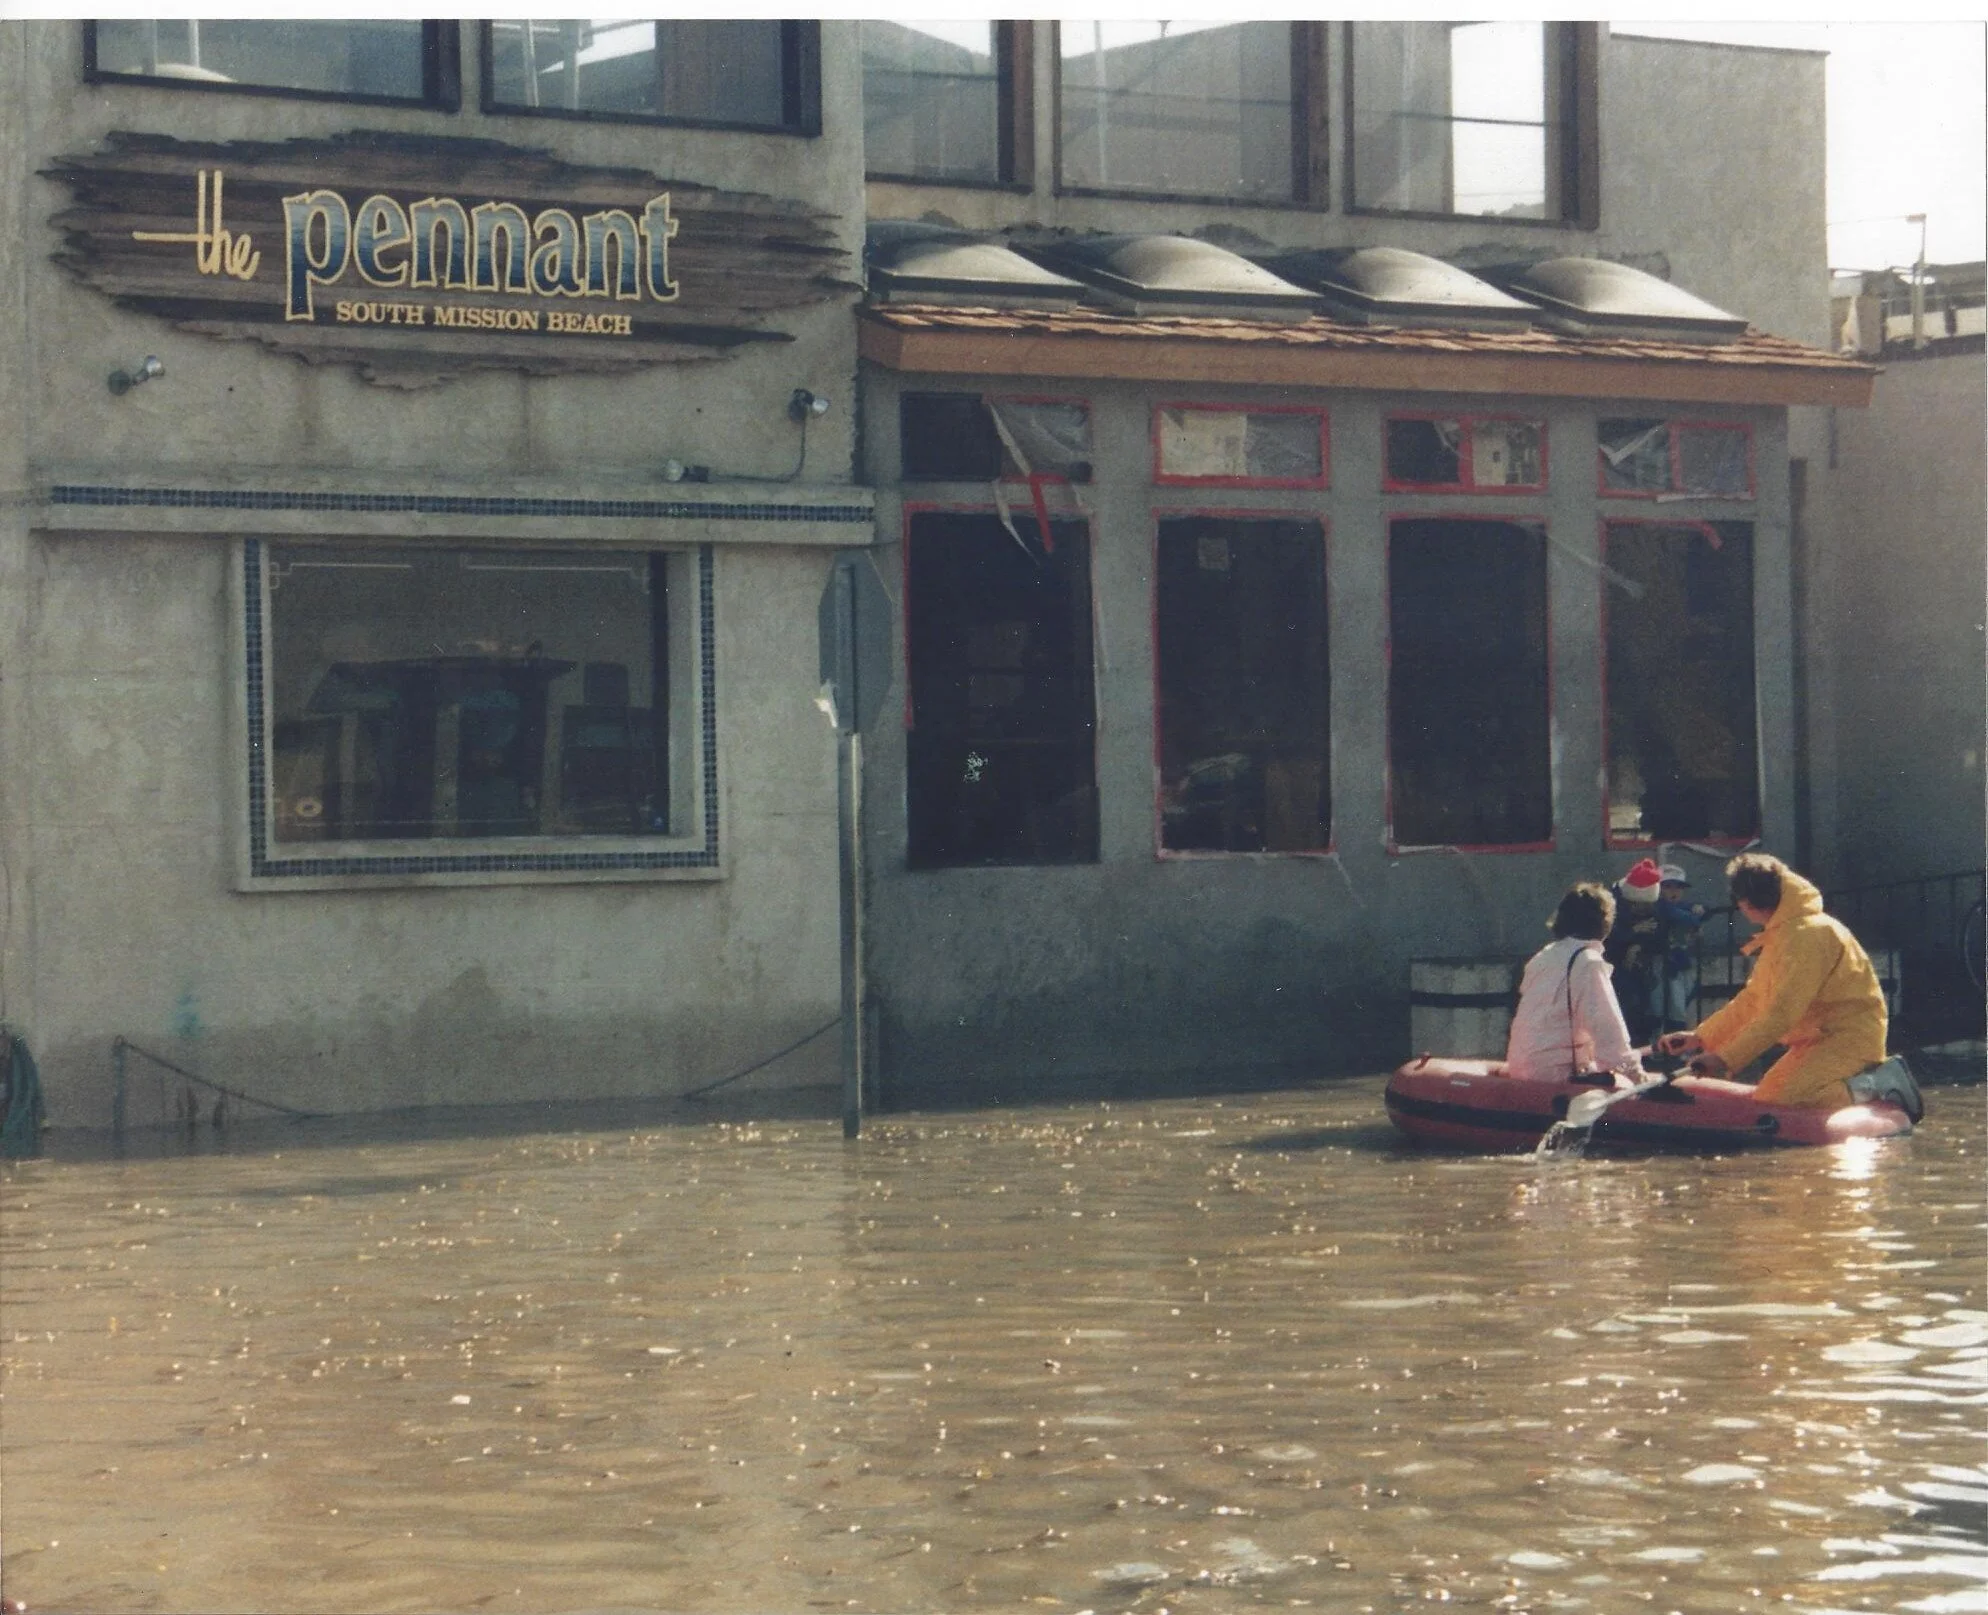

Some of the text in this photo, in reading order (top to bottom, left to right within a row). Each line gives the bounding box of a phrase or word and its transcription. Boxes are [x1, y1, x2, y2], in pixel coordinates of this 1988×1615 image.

[131, 170, 680, 322] the pennant
[336, 300, 633, 336] SOUTH MISSION BEACH
